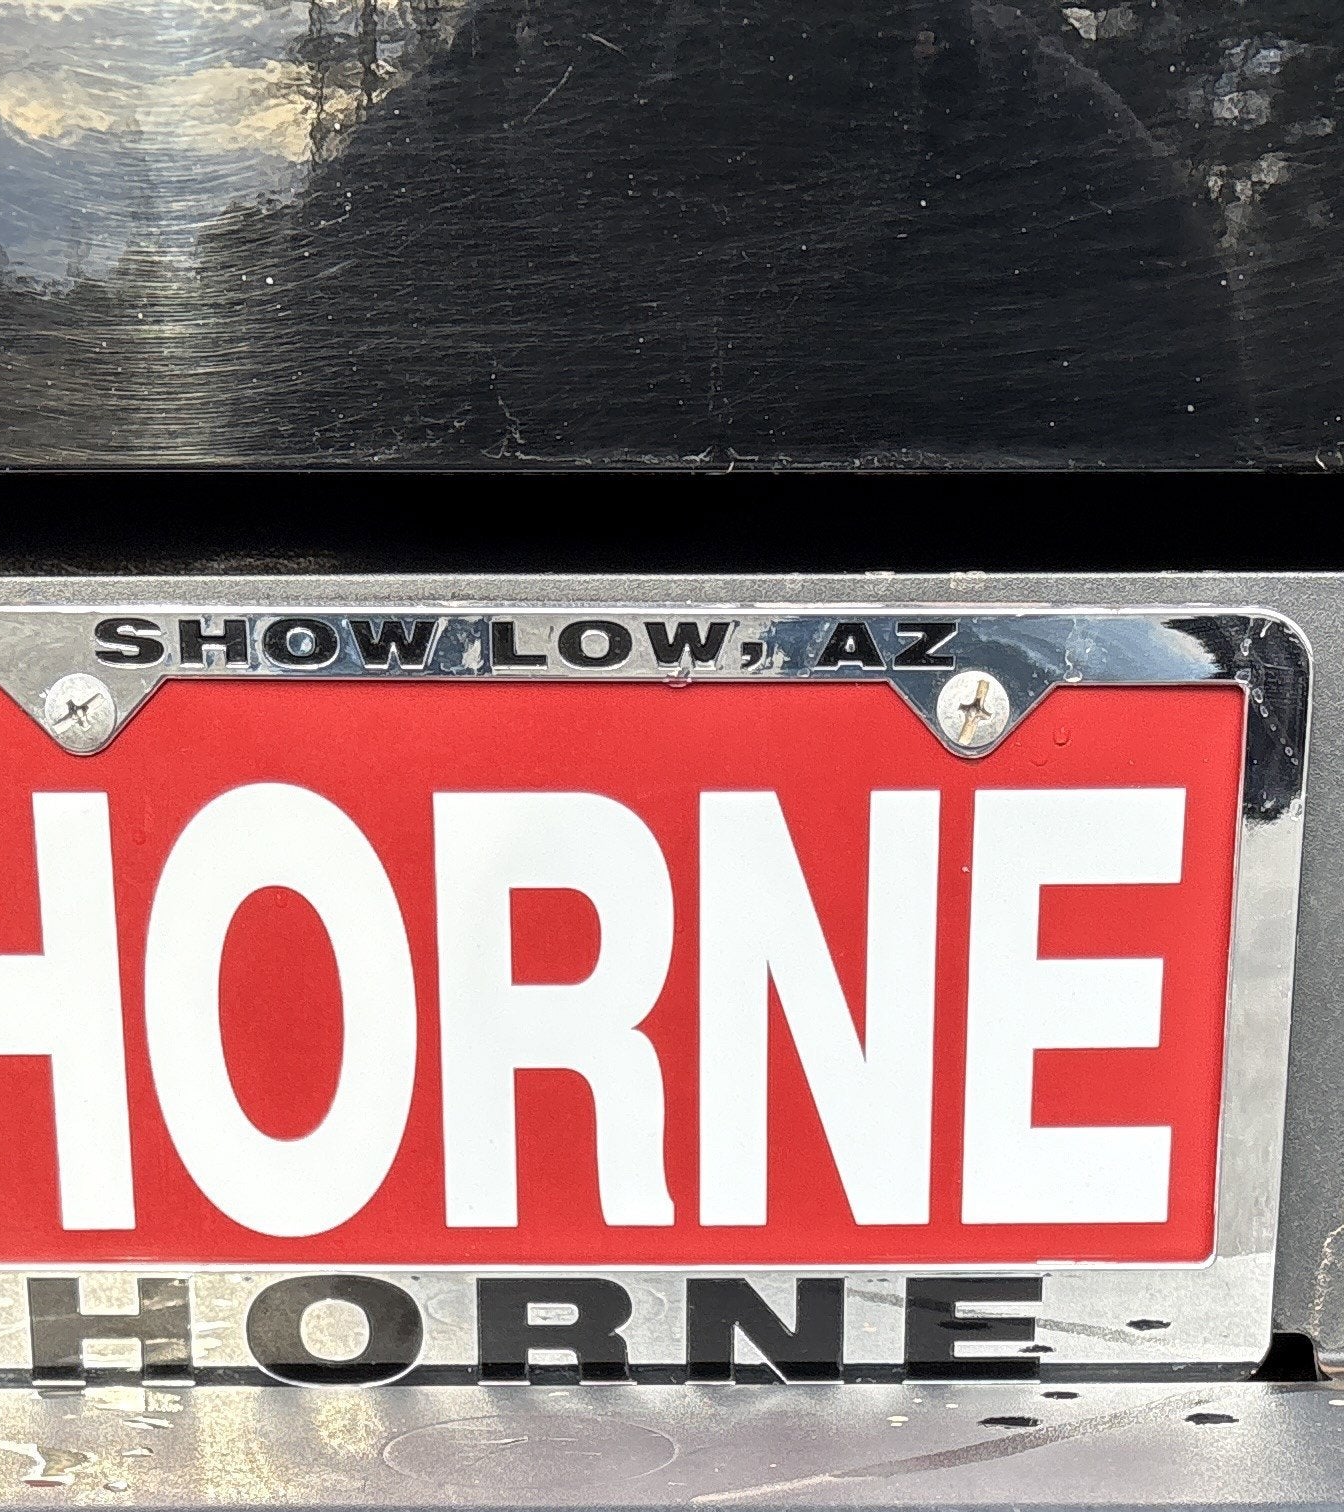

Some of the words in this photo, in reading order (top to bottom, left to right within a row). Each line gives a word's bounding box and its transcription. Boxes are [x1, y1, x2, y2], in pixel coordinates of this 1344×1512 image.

[94, 617, 442, 669] SHOW
[490, 618, 765, 671] LOW,
[812, 620, 960, 670] AZ
[25, 1273, 1045, 1388] HORNE
